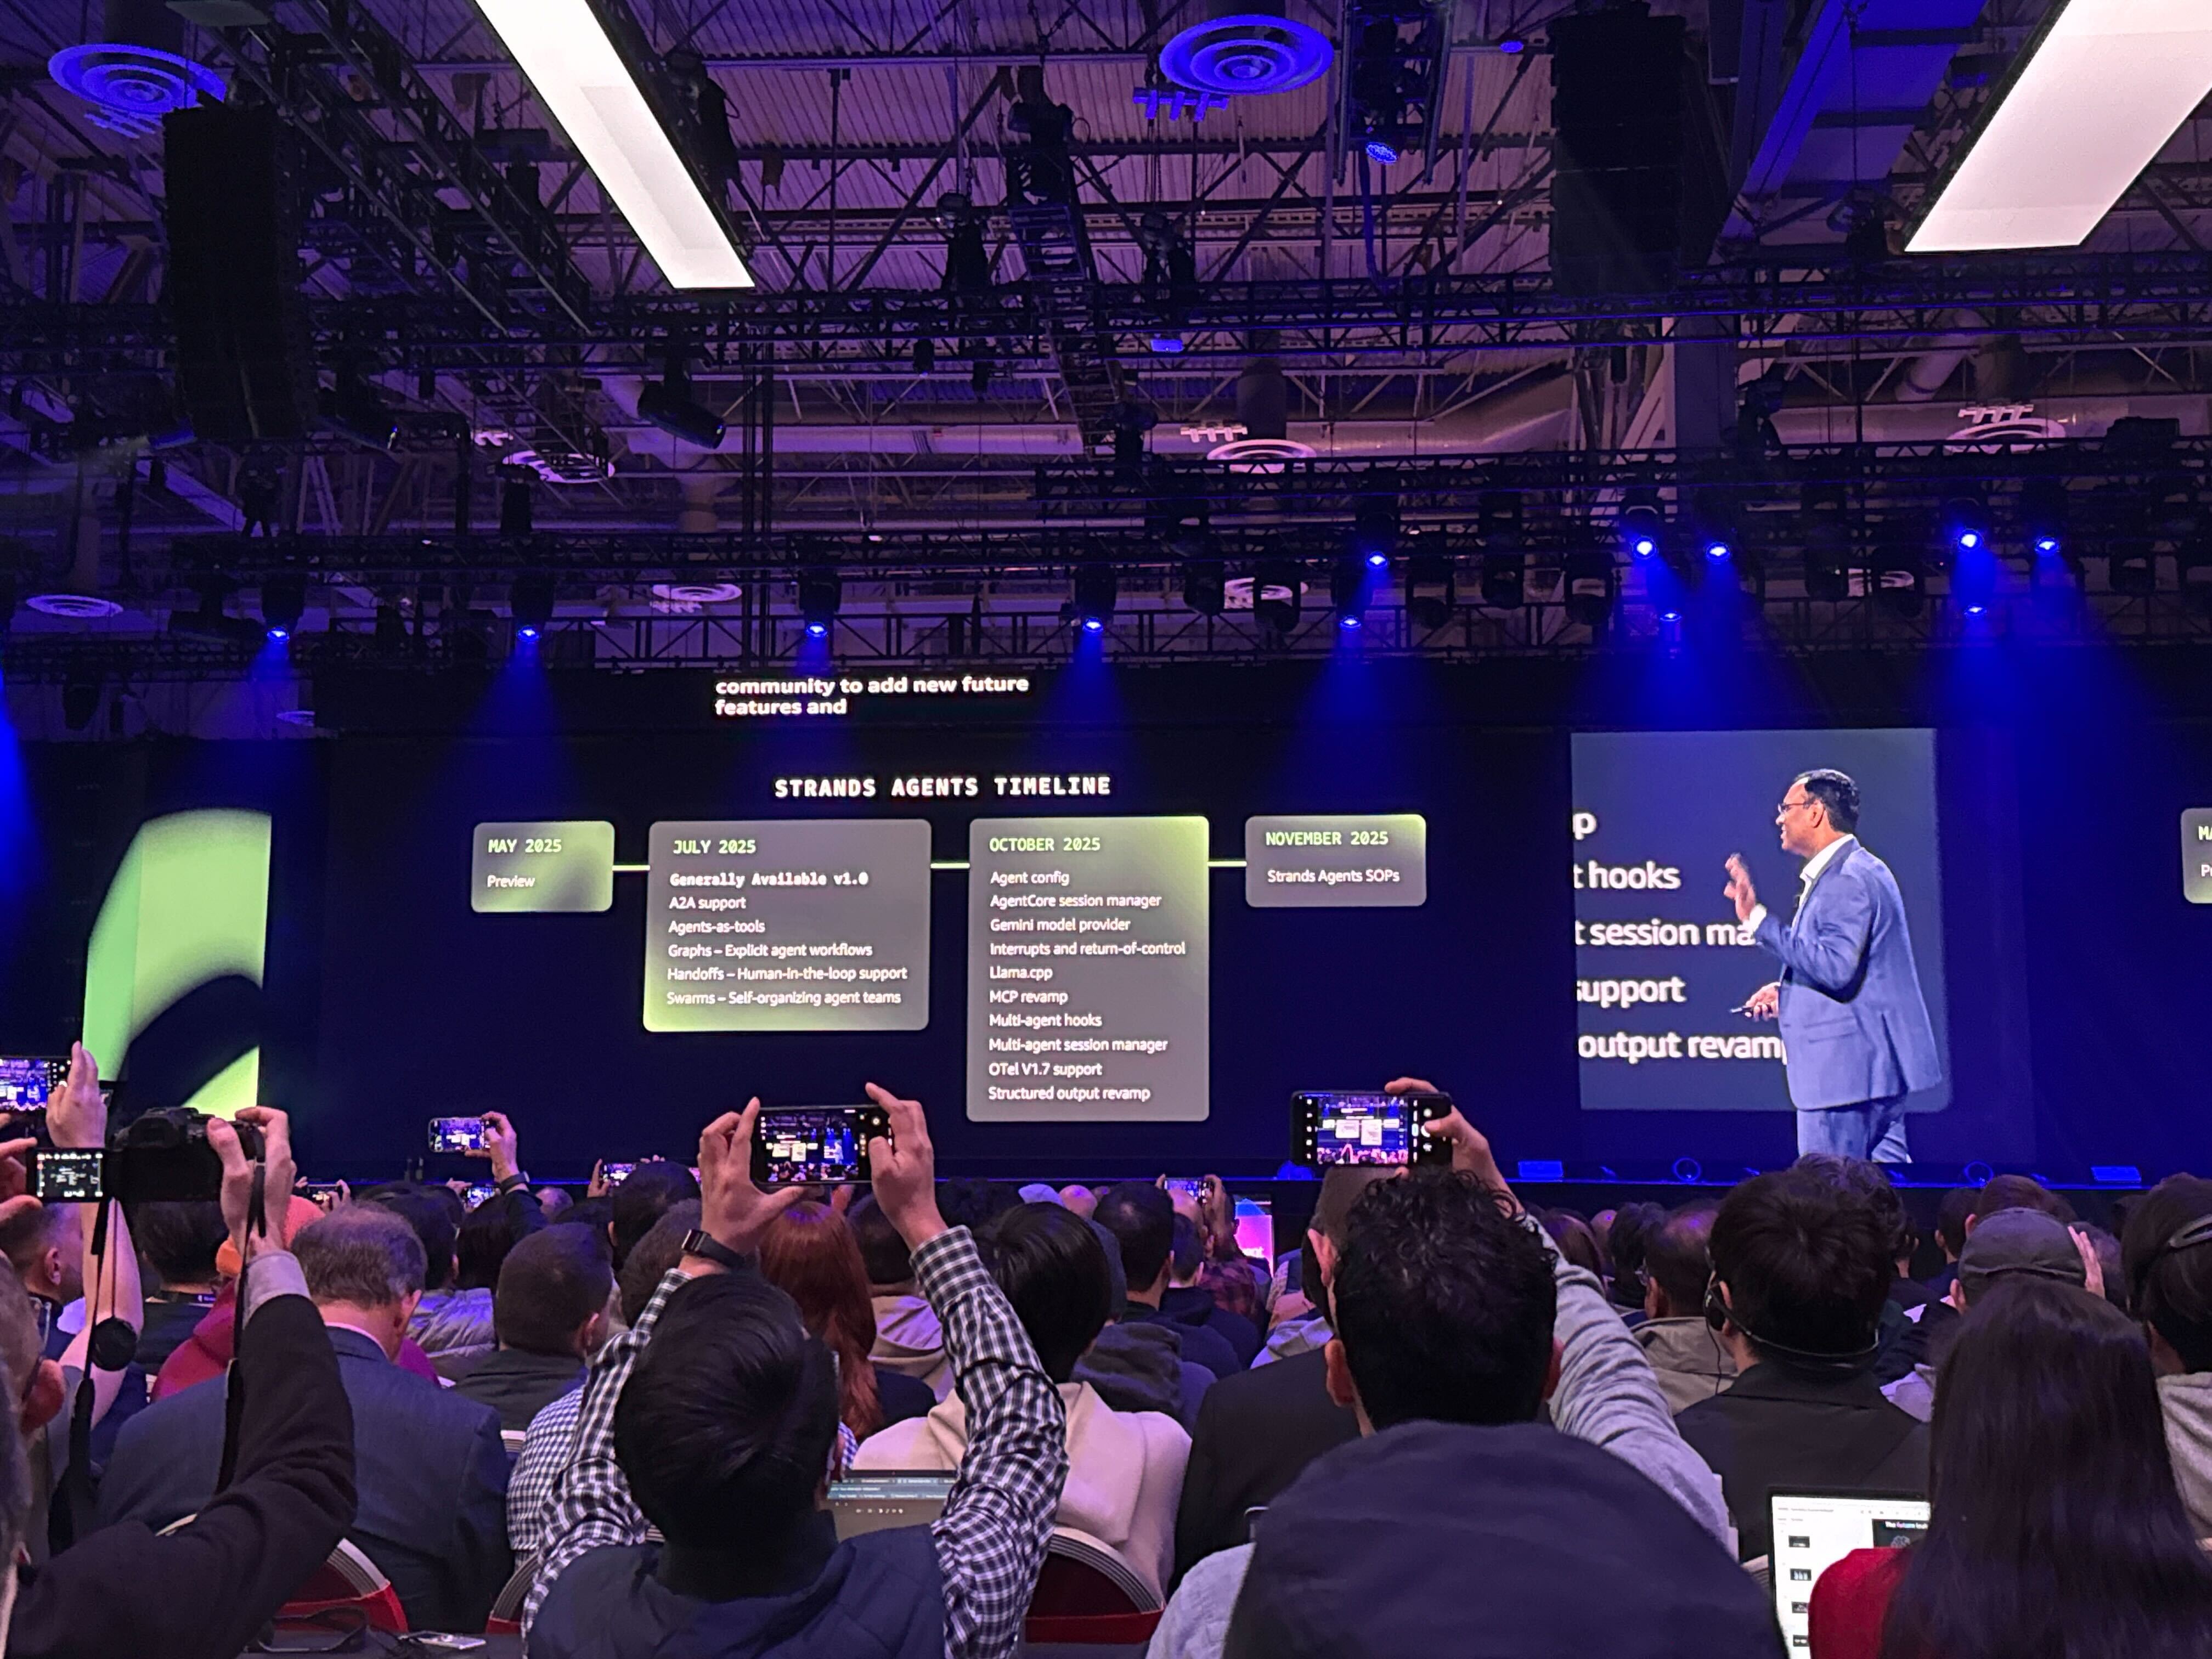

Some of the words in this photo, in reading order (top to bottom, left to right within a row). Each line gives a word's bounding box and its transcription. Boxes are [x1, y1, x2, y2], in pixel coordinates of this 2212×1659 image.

[715, 678, 836, 697] community
[839, 679, 864, 693] to
[867, 676, 908, 693] add
[913, 680, 957, 693] new
[961, 675, 1029, 692] future
[714, 699, 802, 715] features
[806, 698, 847, 714] and
[775, 778, 876, 798] STRANDS
[891, 777, 978, 797] AGENTS
[994, 776, 1110, 795] TIMELINE
[488, 839, 517, 853] MAY
[525, 838, 562, 853] 2025
[673, 839, 711, 854] JULY
[718, 839, 756, 854] 2025
[989, 837, 1054, 852] OCTOBER
[1063, 837, 1101, 851] 2025
[1266, 831, 1342, 846] NOVEMBER
[1351, 831, 1389, 845] 2025
[487, 874, 536, 888] Preview
[670, 872, 746, 888] Generally
[751, 872, 827, 885] Available
[833, 872, 868, 885] v1.0
[990, 871, 1029, 887] Agent
[1031, 870, 1070, 887] config
[1267, 869, 1316, 883] Strands
[1317, 870, 1363, 885] Agents
[1365, 868, 1400, 882] SOPs
[1588, 860, 1681, 889] hooks
[669, 896, 696, 909] A2A
[698, 896, 747, 911] support
[990, 894, 1057, 910] AgentCore
[1059, 894, 1103, 907] session
[1107, 896, 1162, 909] manager
[668, 919, 766, 936] Agents-as-tools
[990, 918, 1034, 931] Gemini
[1037, 917, 1076, 931] model
[1079, 917, 1131, 933] provider
[1589, 918, 1700, 946] session
[668, 944, 712, 960] Graphs
[725, 943, 769, 959] Explicit
[771, 944, 807, 960] agent
[809, 943, 873, 956] workflows
[990, 943, 1051, 958] Interrupts
[1053, 941, 1077, 955] and
[1080, 941, 1186, 955] return-of-control
[667, 967, 724, 980] Handoffs
[737, 966, 856, 982] Human-in-the-loop
[859, 967, 908, 982] support
[990, 965, 1053, 981] Llama.cpp
[665, 991, 715, 1005] Swarms
[729, 991, 822, 1007] Self-organizing
[824, 991, 861, 1007] agent
[862, 991, 901, 1003] teams
[990, 990, 1019, 1003] MCP
[1020, 992, 1068, 1006] revamp
[989, 1013, 1062, 1030] Multi-agent
[1064, 1013, 1102, 1027] hooks
[989, 1037, 1062, 1054] Multi-agent
[1064, 1038, 1109, 1051] session
[1111, 1040, 1168, 1054] manager
[1578, 1031, 1683, 1064] output
[1688, 1036, 1788, 1065] revam
[989, 1062, 1019, 1076] OTel
[1021, 1062, 1051, 1075] V1.7
[1053, 1063, 1103, 1078] support
[988, 1086, 1054, 1100] Structured
[1056, 1087, 1100, 1102] output
[1102, 1088, 1150, 1102] revamp
